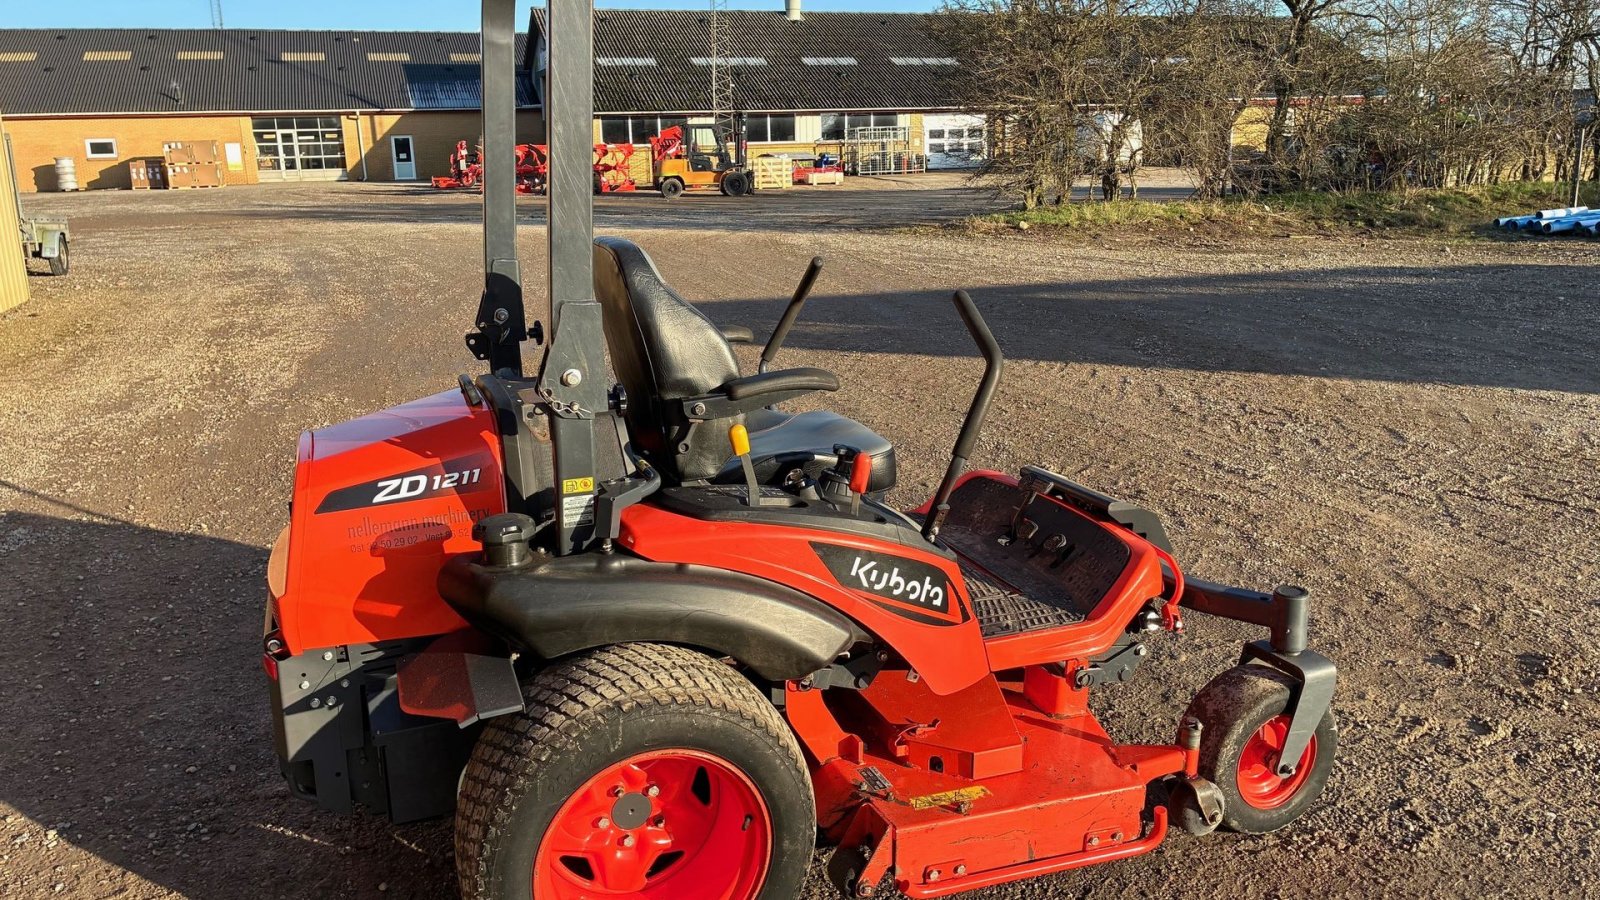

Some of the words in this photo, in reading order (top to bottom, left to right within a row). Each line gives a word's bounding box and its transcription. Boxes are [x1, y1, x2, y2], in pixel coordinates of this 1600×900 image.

[372, 475, 428, 503] ZD
[432, 468, 480, 490] 1211
[851, 556, 943, 606] Kubota
